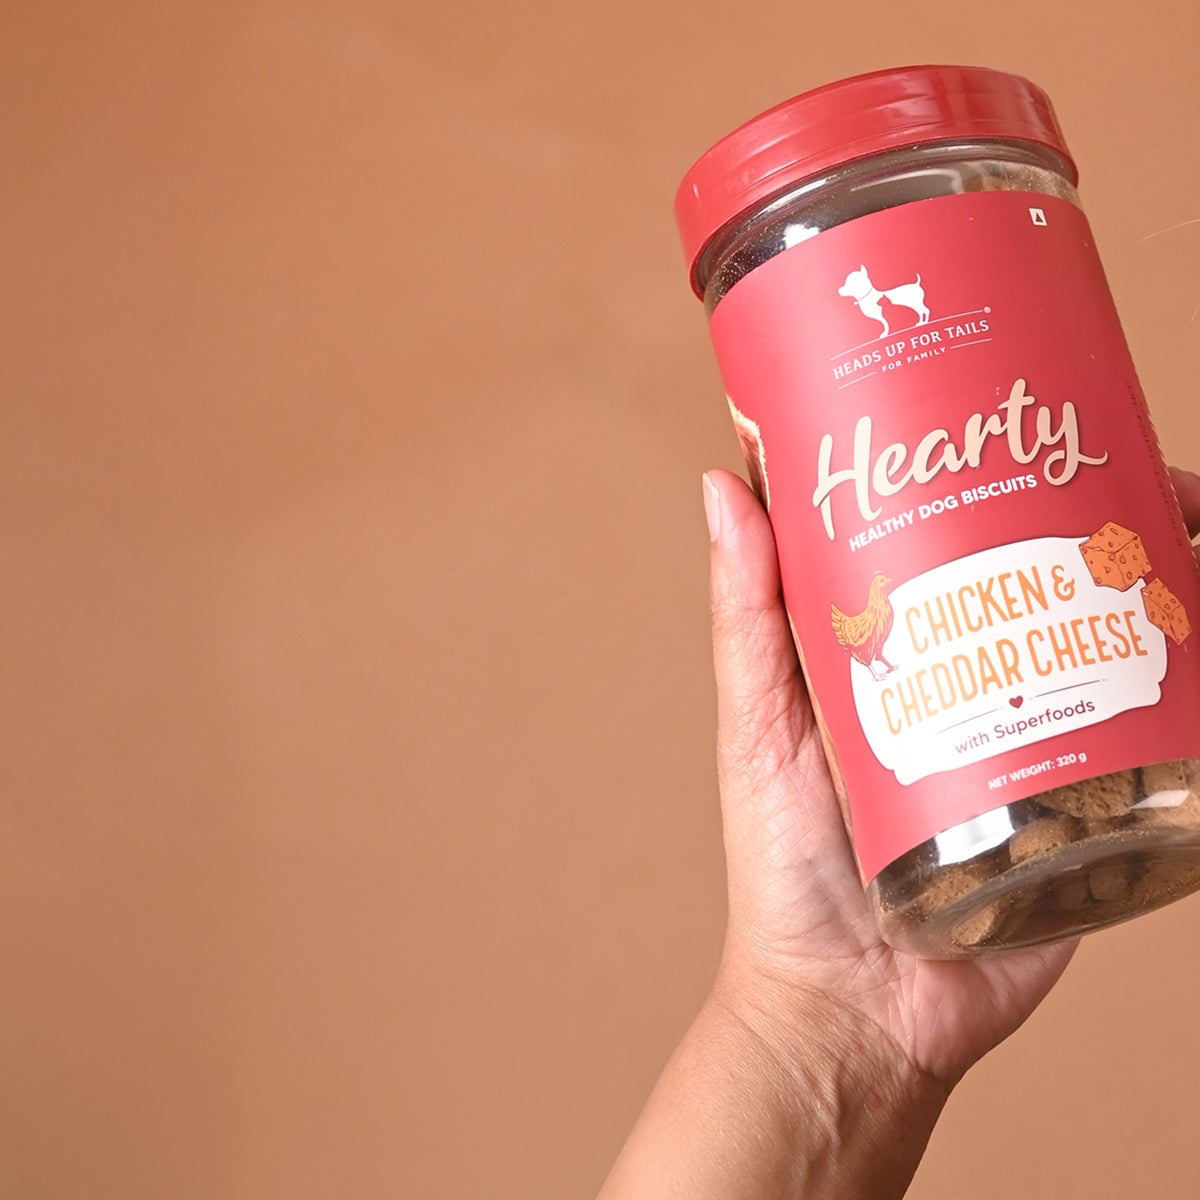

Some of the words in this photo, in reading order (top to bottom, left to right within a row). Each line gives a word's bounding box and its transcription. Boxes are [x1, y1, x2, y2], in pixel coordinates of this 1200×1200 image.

[833, 350, 882, 380] HEADS
[885, 341, 906, 357] UP
[910, 331, 942, 349] FOR
[944, 320, 990, 339] TAILS
[882, 360, 902, 372] FOR
[907, 346, 946, 363] FAMILY
[812, 378, 1108, 541] Hearty
[848, 510, 915, 552] HEALTHY
[918, 495, 959, 520] DOG
[961, 474, 1038, 505] BISCUITS
[905, 565, 1049, 654] CHICKEN
[1051, 564, 1075, 602] &
[880, 638, 1024, 736] CHEDDAR
[1025, 610, 1149, 677] CHEESE
[955, 730, 991, 755] with
[994, 699, 1096, 740] Superfoods
[987, 775, 1008, 790] NET
[1009, 759, 1055, 781] WEIGHT:
[1056, 753, 1077, 768] 320
[1078, 752, 1087, 764] g
